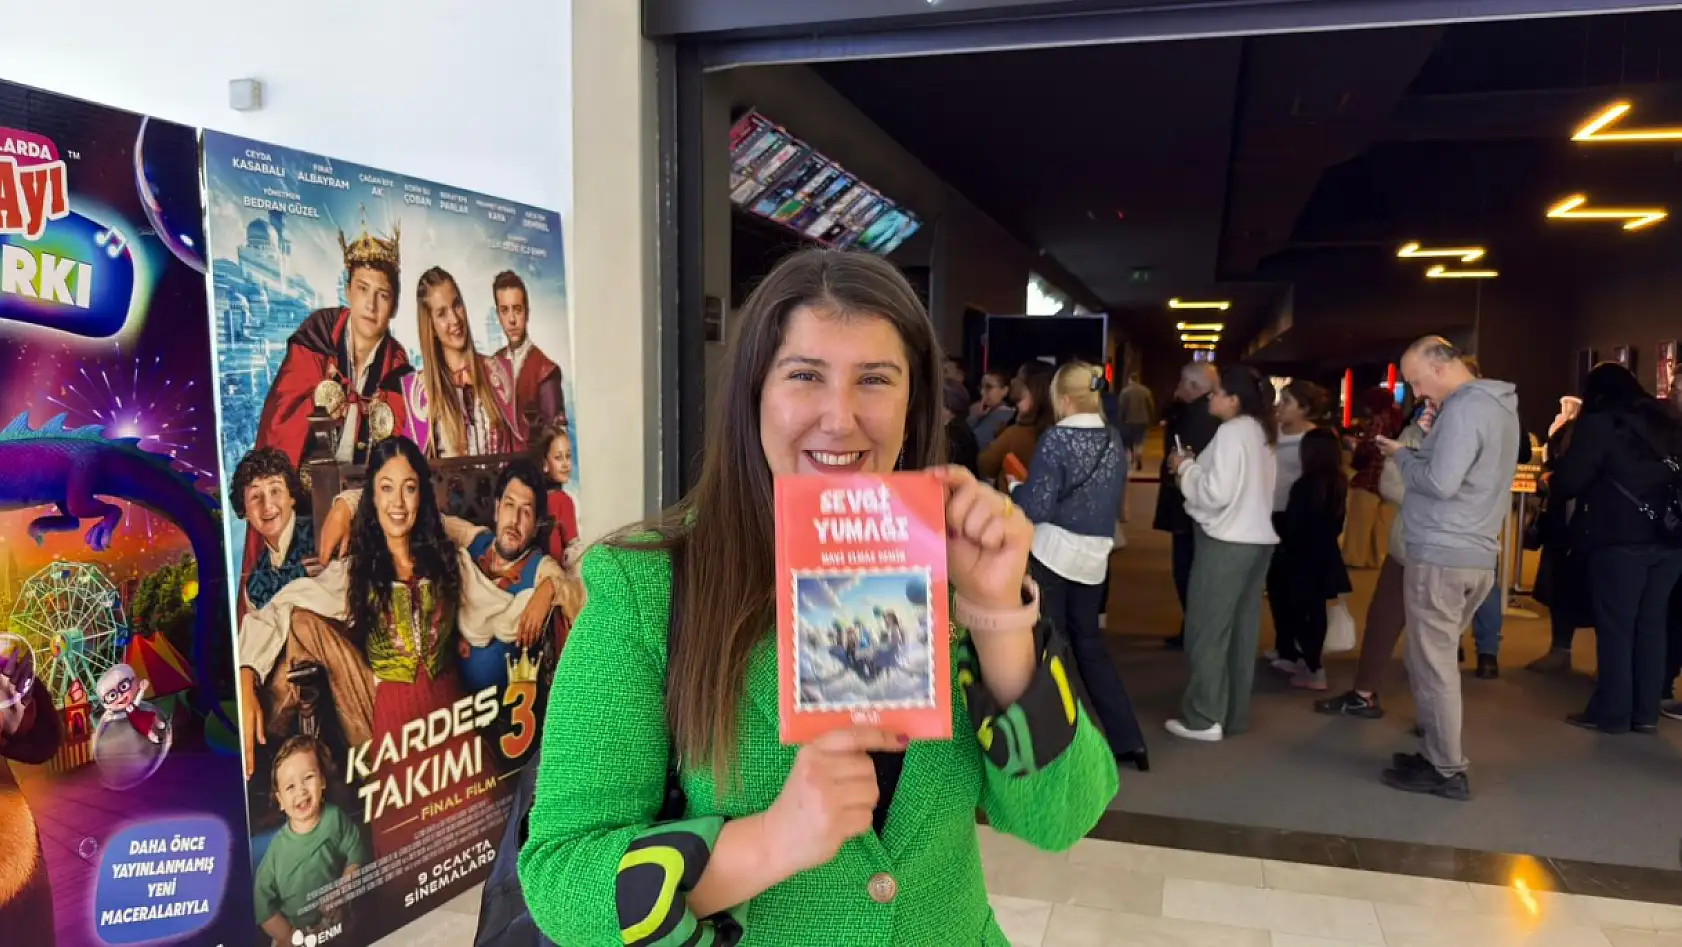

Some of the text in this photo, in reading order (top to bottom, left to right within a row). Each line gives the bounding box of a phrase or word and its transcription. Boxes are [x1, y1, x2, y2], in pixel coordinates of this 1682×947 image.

[245, 149, 272, 161] CEYDA
[231, 157, 286, 178] KASABALI
[297, 171, 350, 190] ALBAYRAM
[242, 196, 320, 218] BEDRAN GÜZEL
[500, 682, 537, 759] 3
[358, 736, 482, 824] TAKIMI
[129, 834, 206, 856] DAHA ÖNCE
[111, 856, 215, 879] YAYINLANMAMIŞ
[418, 838, 492, 885] 9 OCAK'TA
[147, 878, 177, 897] YENİ
[100, 899, 210, 926] MACERALARIYLA
[318, 922, 342, 944] ENM
